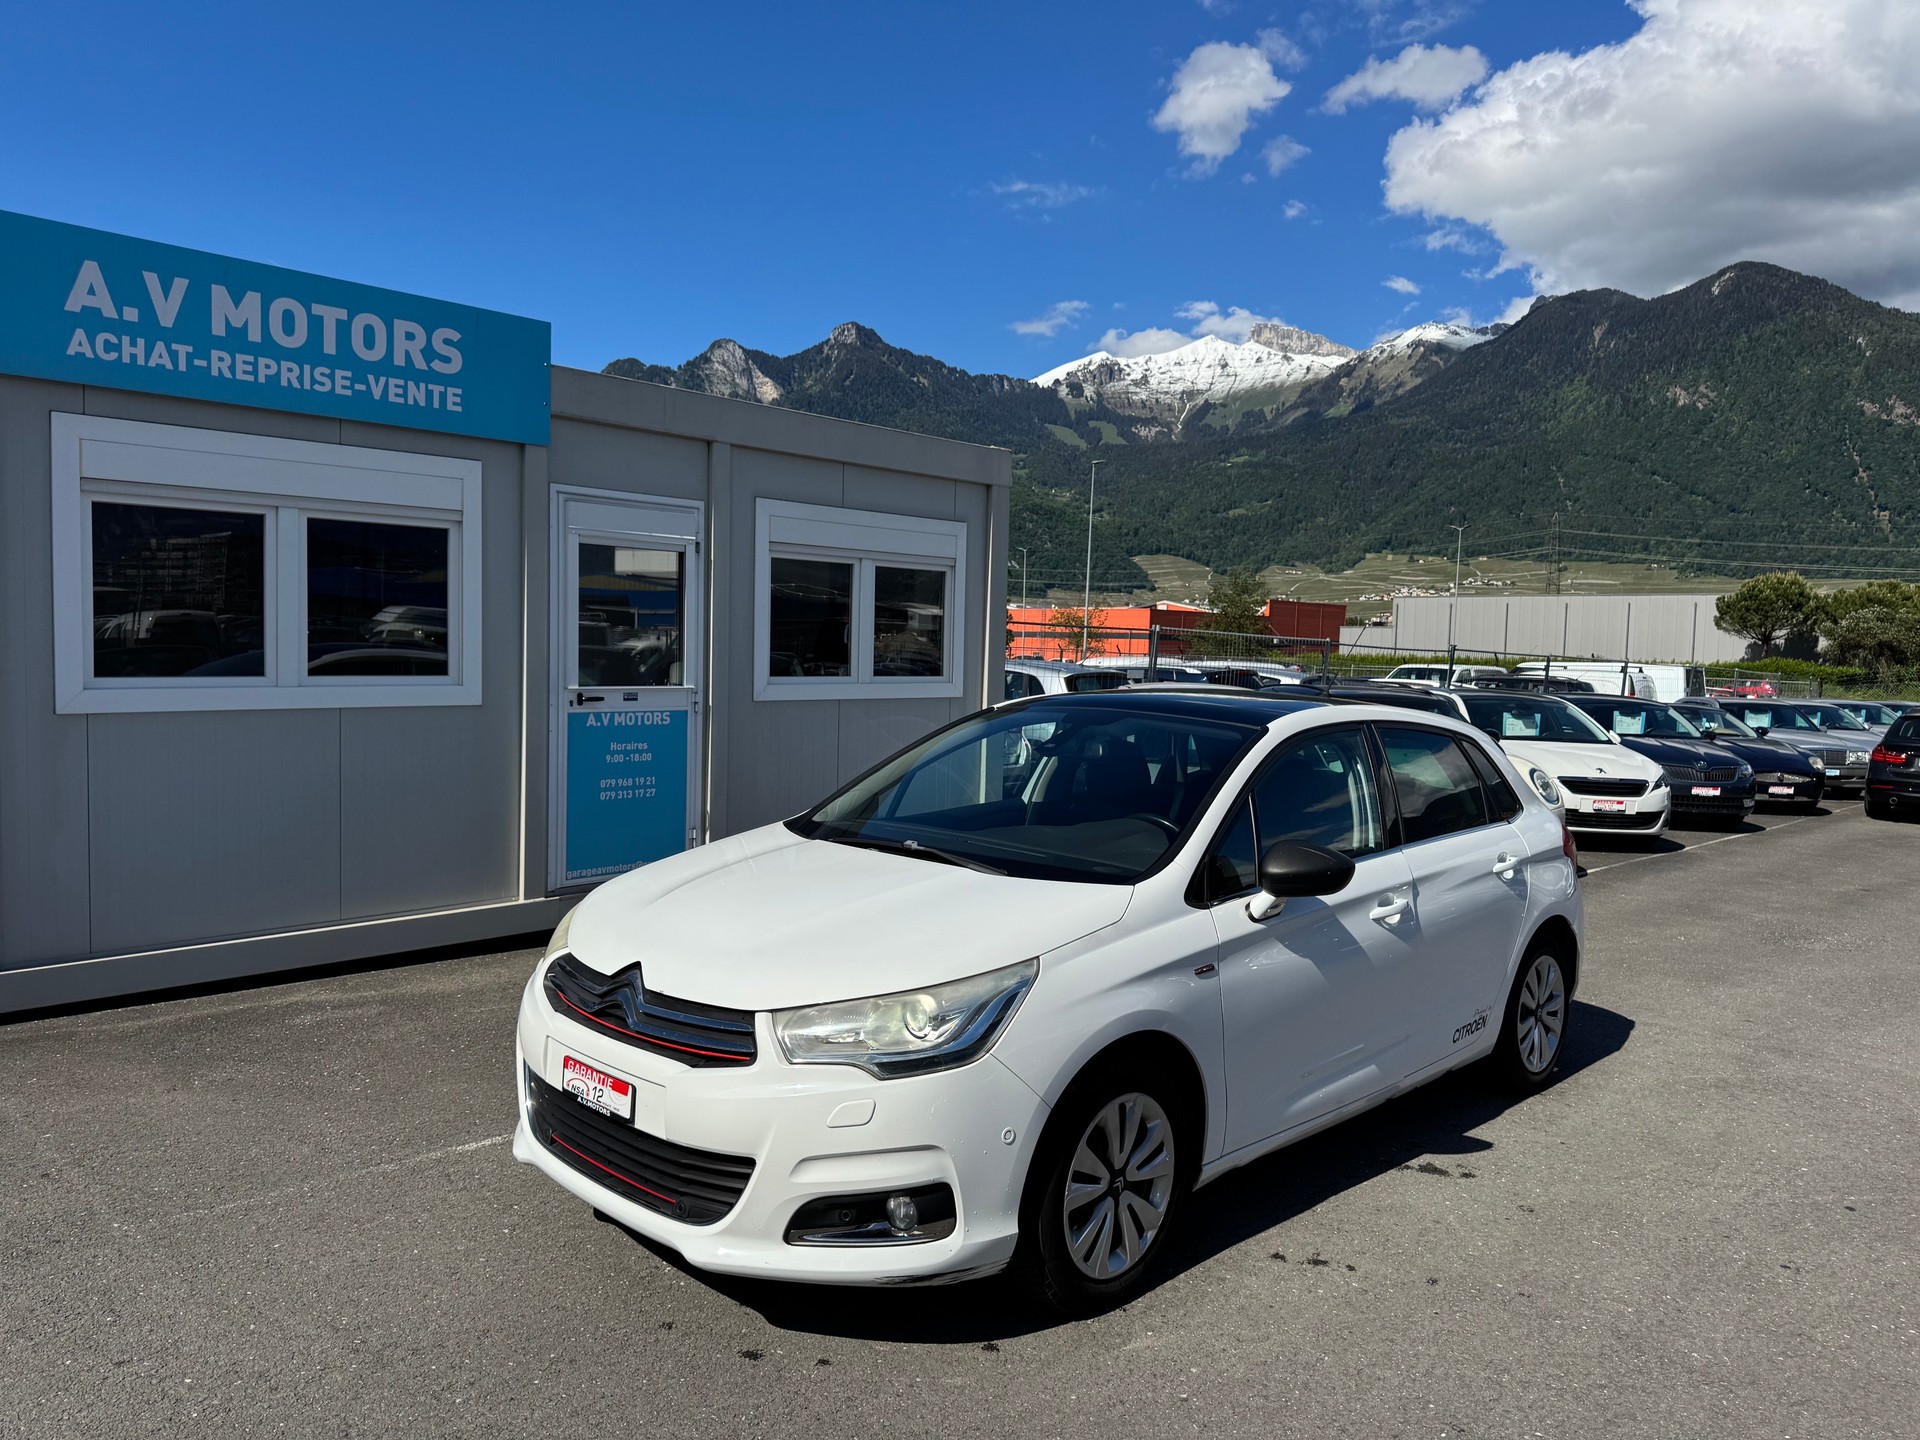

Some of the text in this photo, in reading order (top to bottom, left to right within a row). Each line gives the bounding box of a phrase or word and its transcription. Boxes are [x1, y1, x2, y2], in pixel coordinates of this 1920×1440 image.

[64, 259, 463, 375] A.V MOTORS
[66, 328, 463, 412] ACHAT-REPRISE-VENTE
[586, 712, 671, 726] A.V MOTORS
[610, 741, 648, 750] Horaires
[605, 754, 624, 763] 9:00
[600, 776, 656, 788] 079 968 19 21
[600, 788, 656, 800] 079 313 17 27
[1452, 1013, 1489, 1044] CITROËN
[567, 1060, 614, 1090] GARANTIE
[570, 1083, 585, 1096] NSA
[592, 1085, 604, 1104] 12
